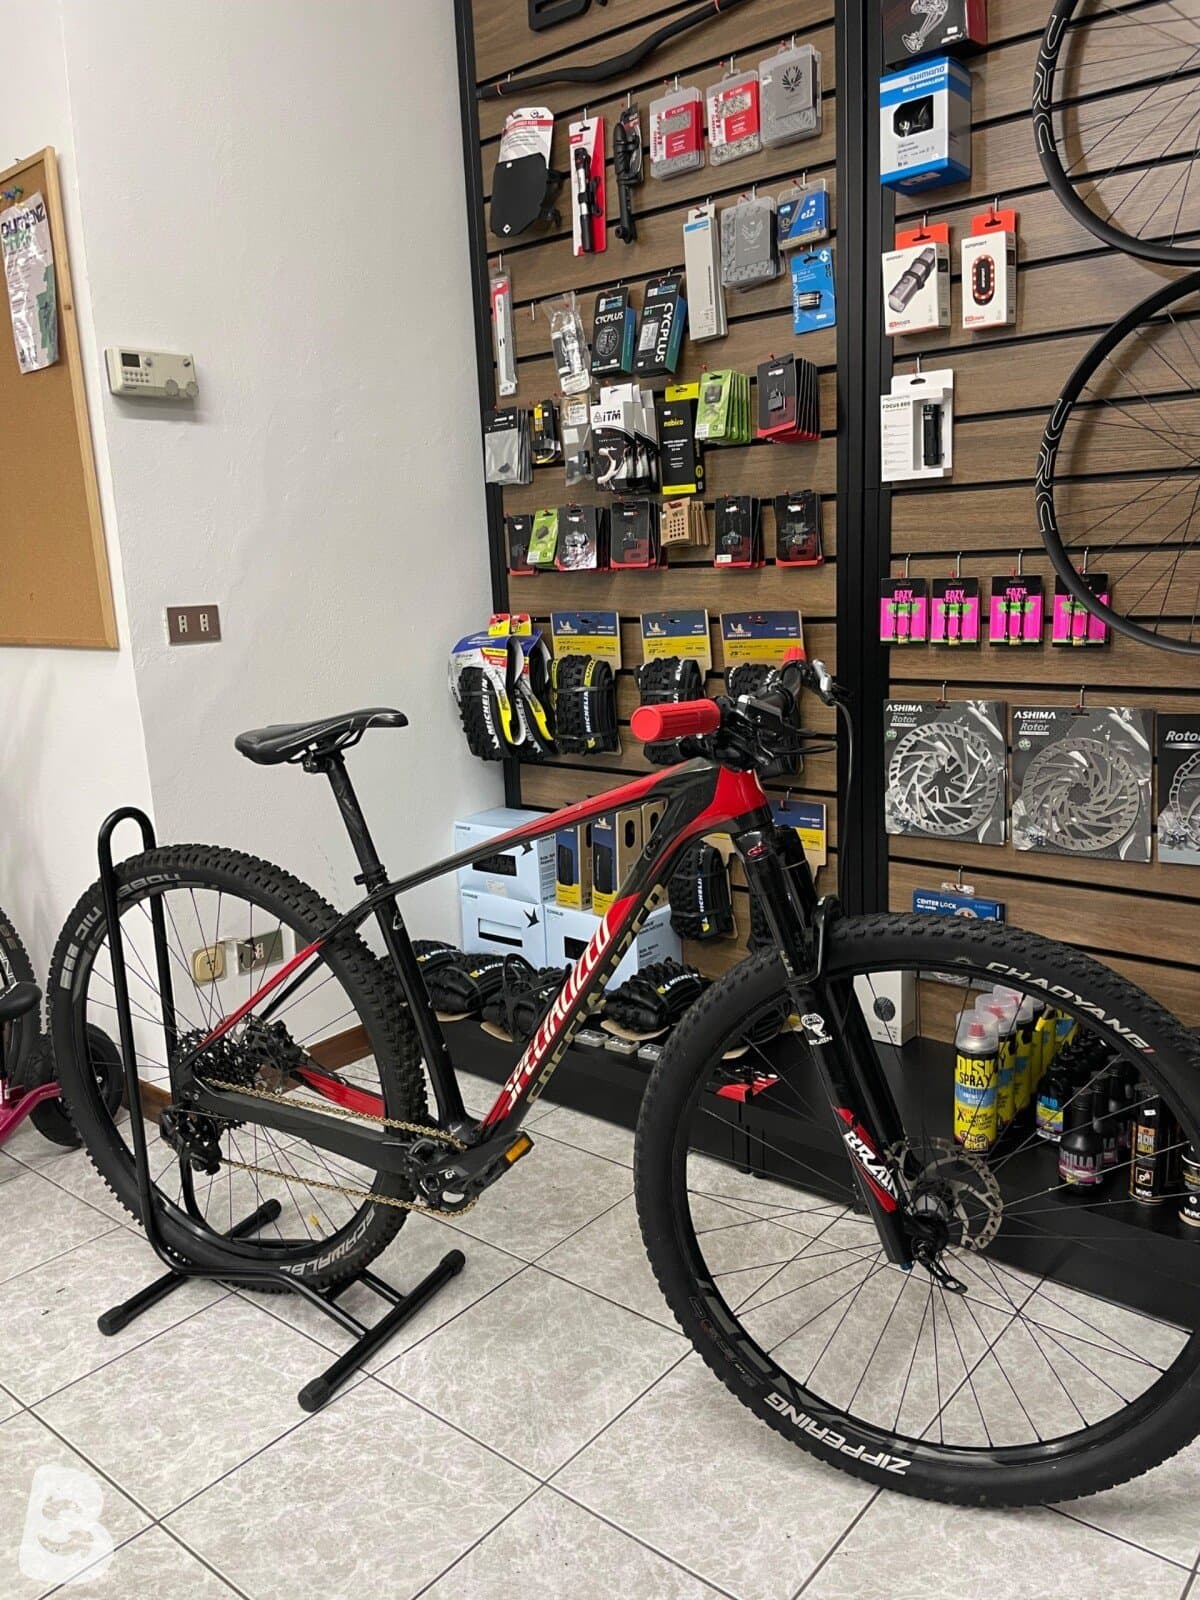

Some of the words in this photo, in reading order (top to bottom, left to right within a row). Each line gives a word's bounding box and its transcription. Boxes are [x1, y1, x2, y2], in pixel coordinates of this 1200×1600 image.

[908, 65, 945, 81] SHIMANO
[595, 311, 624, 325] CYCPLUS
[655, 302, 674, 363] CYCPLUS
[481, 678, 496, 736] MICHELIN
[885, 704, 923, 713] ASHIMA
[1013, 711, 1056, 719] ASHIMA
[891, 715, 917, 723] Rotor
[1020, 723, 1049, 731] Rotor
[1165, 730, 1200, 741] Roto
[916, 898, 939, 907] CENTER
[940, 901, 957, 909] LOCK
[503, 912, 612, 1112] SPECIALIZED
[985, 961, 1151, 1049] CHAOYANG
[959, 1072, 993, 1088] SPRAY
[843, 1130, 899, 1200] BRAIN
[763, 1390, 911, 1477] ZIPPERING
